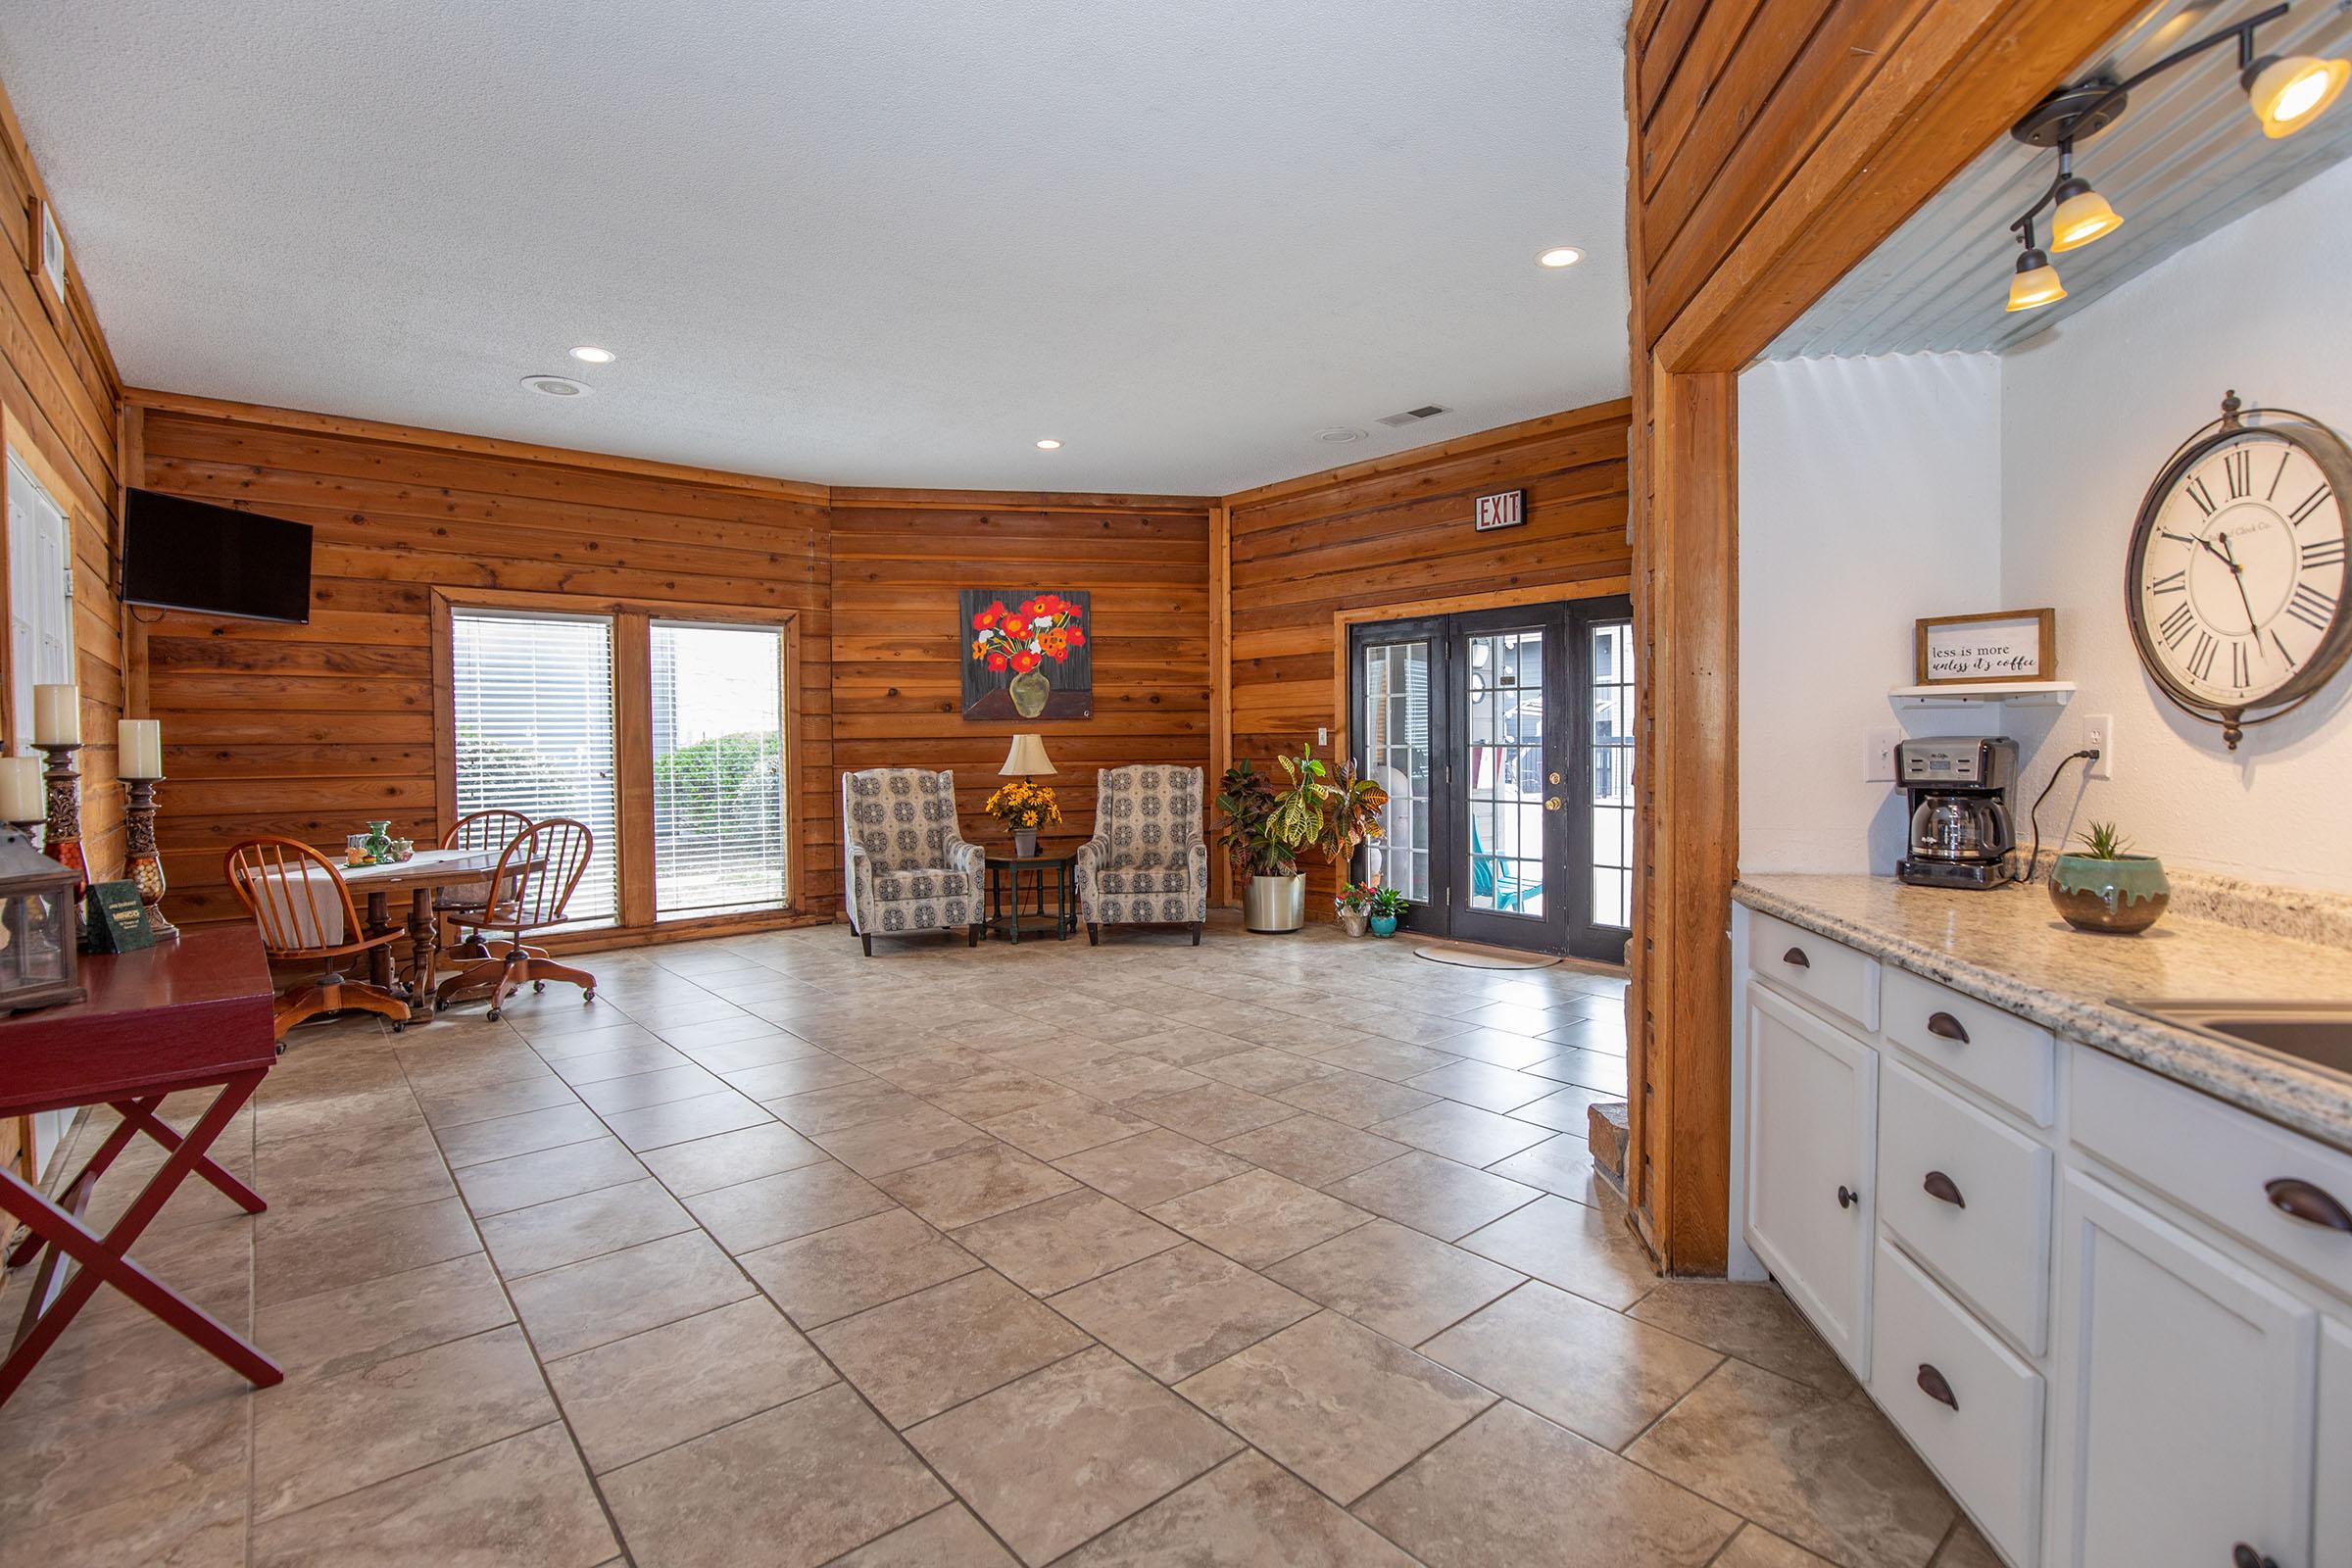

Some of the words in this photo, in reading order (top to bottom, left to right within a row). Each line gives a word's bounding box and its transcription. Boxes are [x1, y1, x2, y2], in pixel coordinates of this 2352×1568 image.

[2185, 475, 2218, 523] XI
[2224, 449, 2251, 503] XII
[2266, 451, 2291, 503] I
[1481, 493, 1518, 527] EXIT
[2287, 480, 2333, 527] II
[2300, 537, 2345, 570] III
[2159, 600, 2198, 651] VIII
[1933, 647, 1956, 659] less
[1961, 647, 1973, 657] is
[1978, 646, 2011, 656] more
[1933, 659, 1968, 673] unless
[1973, 658, 1991, 671] it's
[1996, 656, 2035, 670] coffee
[2185, 630, 2221, 682] VII
